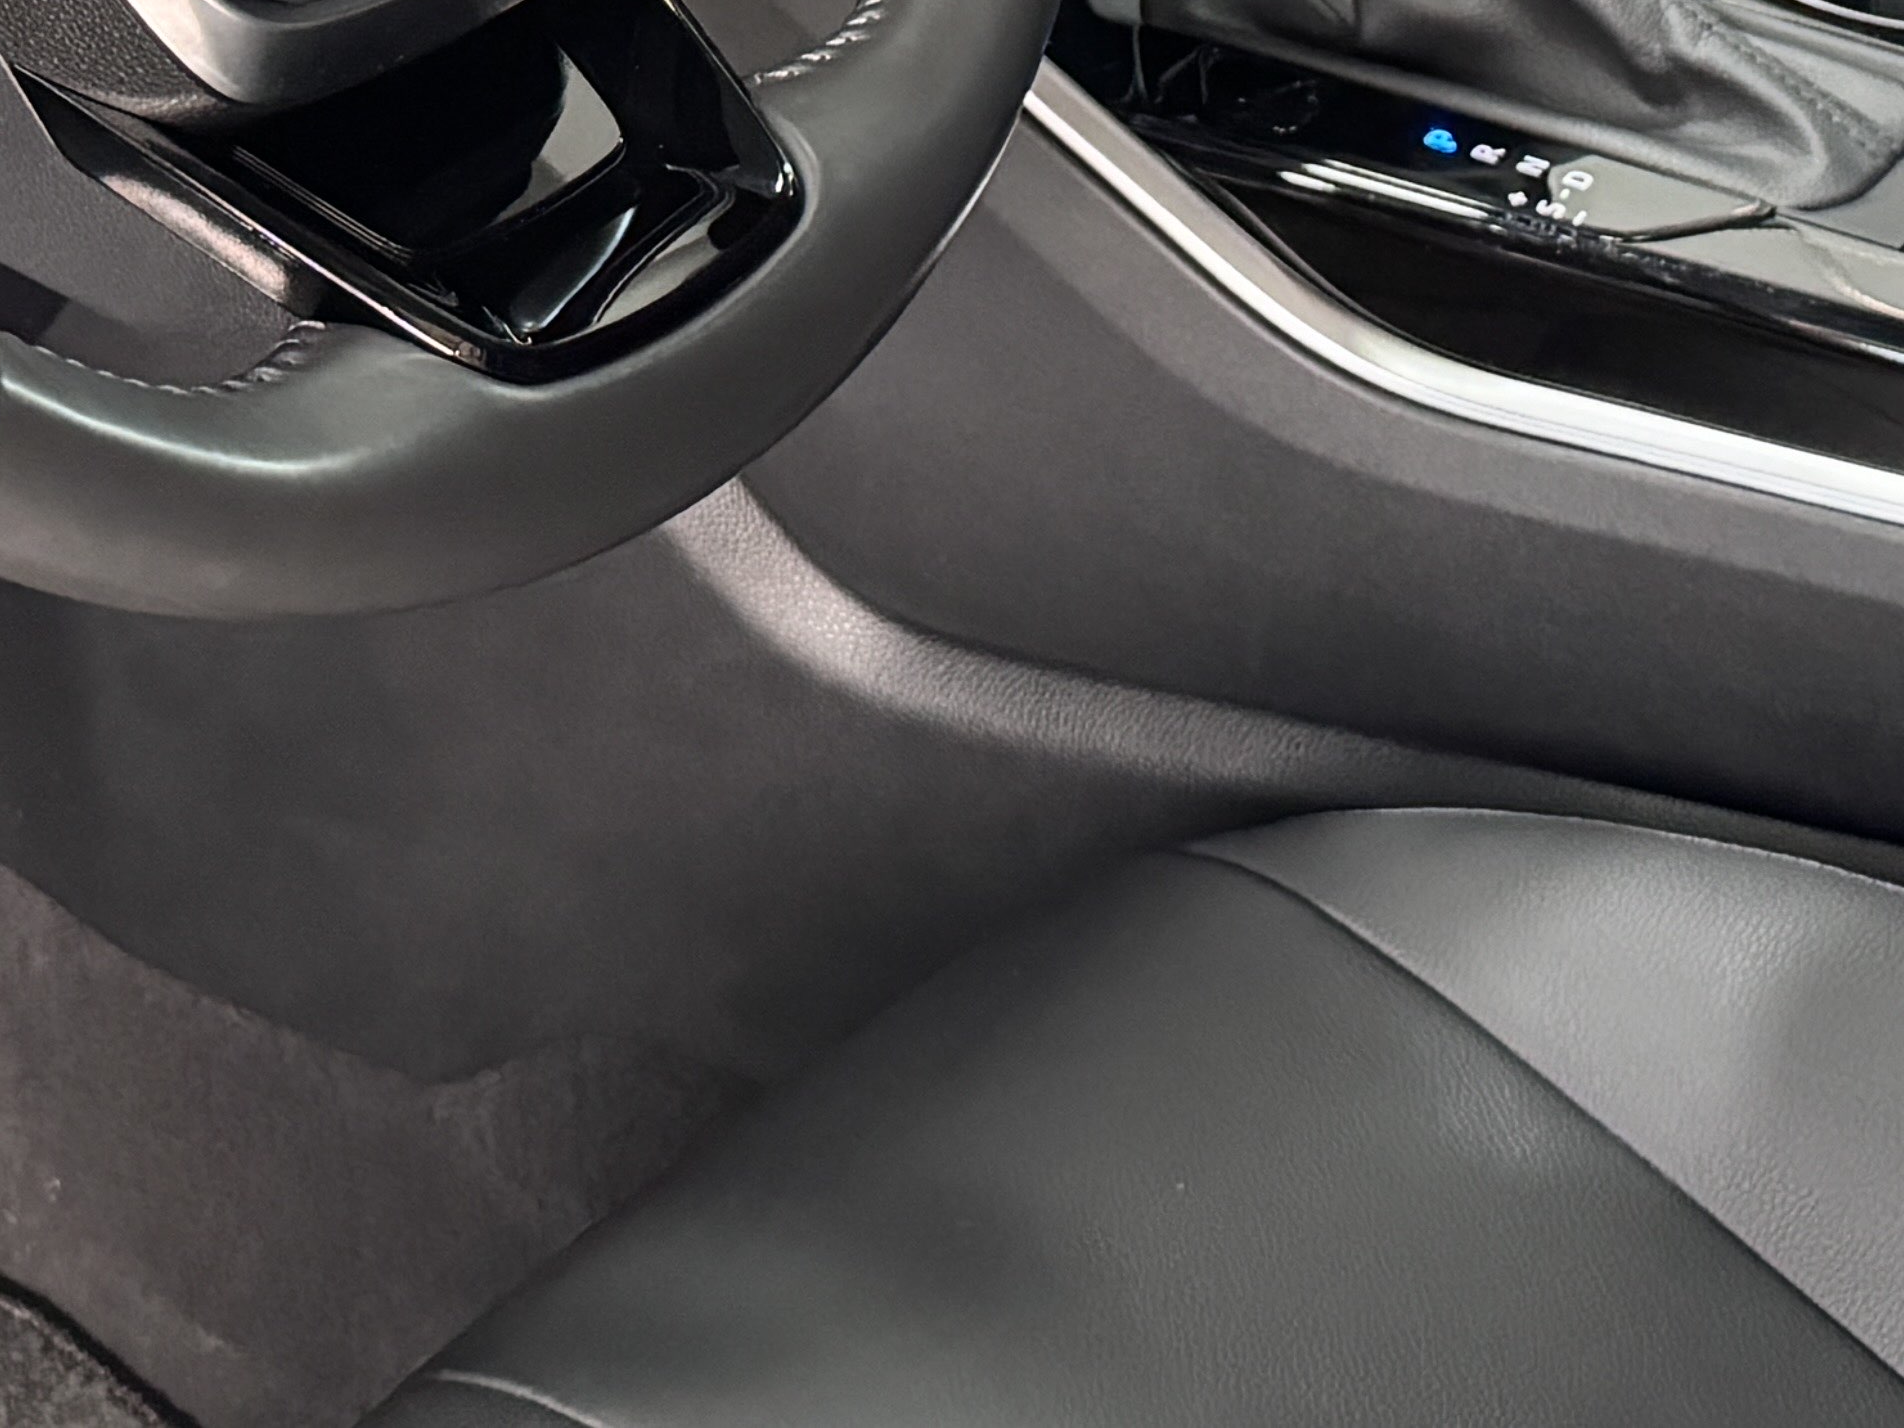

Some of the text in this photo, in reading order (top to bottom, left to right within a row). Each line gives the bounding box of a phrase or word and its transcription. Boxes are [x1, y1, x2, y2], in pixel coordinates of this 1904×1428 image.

[1470, 143, 1506, 166] R
[1515, 154, 1551, 179] N
[1562, 170, 1595, 192] D
